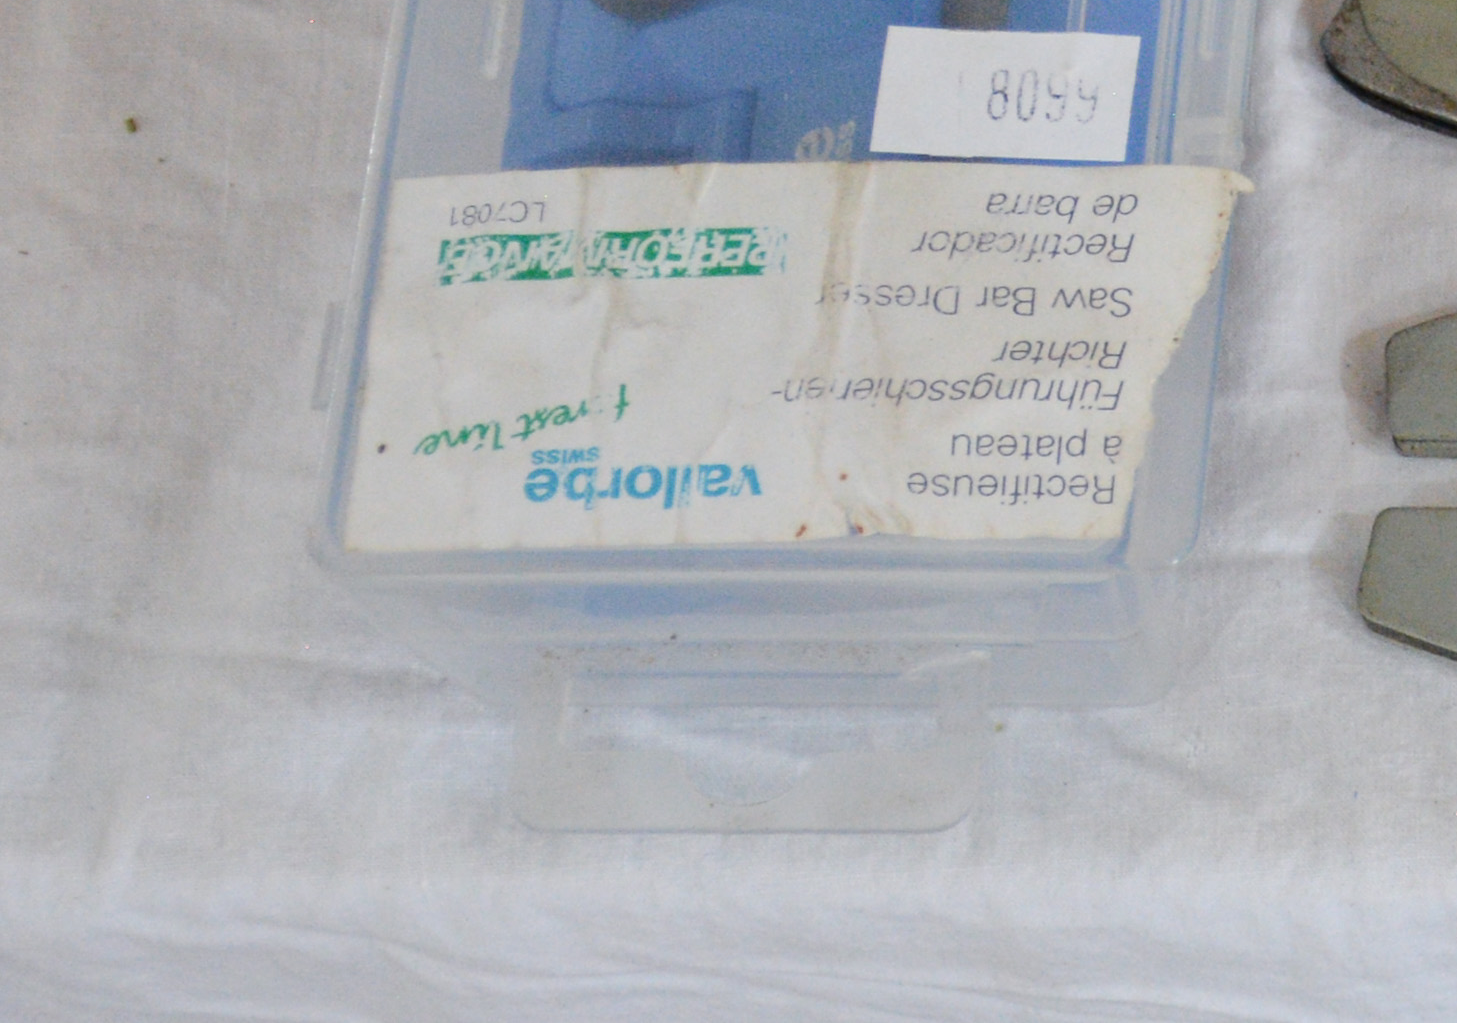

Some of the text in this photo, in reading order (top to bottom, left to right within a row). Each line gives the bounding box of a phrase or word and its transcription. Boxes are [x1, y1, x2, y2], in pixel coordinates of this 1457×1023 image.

[449, 200, 546, 227] LC7081
[985, 192, 1139, 223] de barra
[910, 230, 1135, 264] Rectificador
[976, 286, 1037, 316] Bar
[1051, 286, 1134, 318] Saw
[991, 339, 1128, 370] Richter
[511, 383, 630, 442] frest
[950, 428, 1088, 465] plateau
[906, 472, 1116, 506] Rectifieuse
